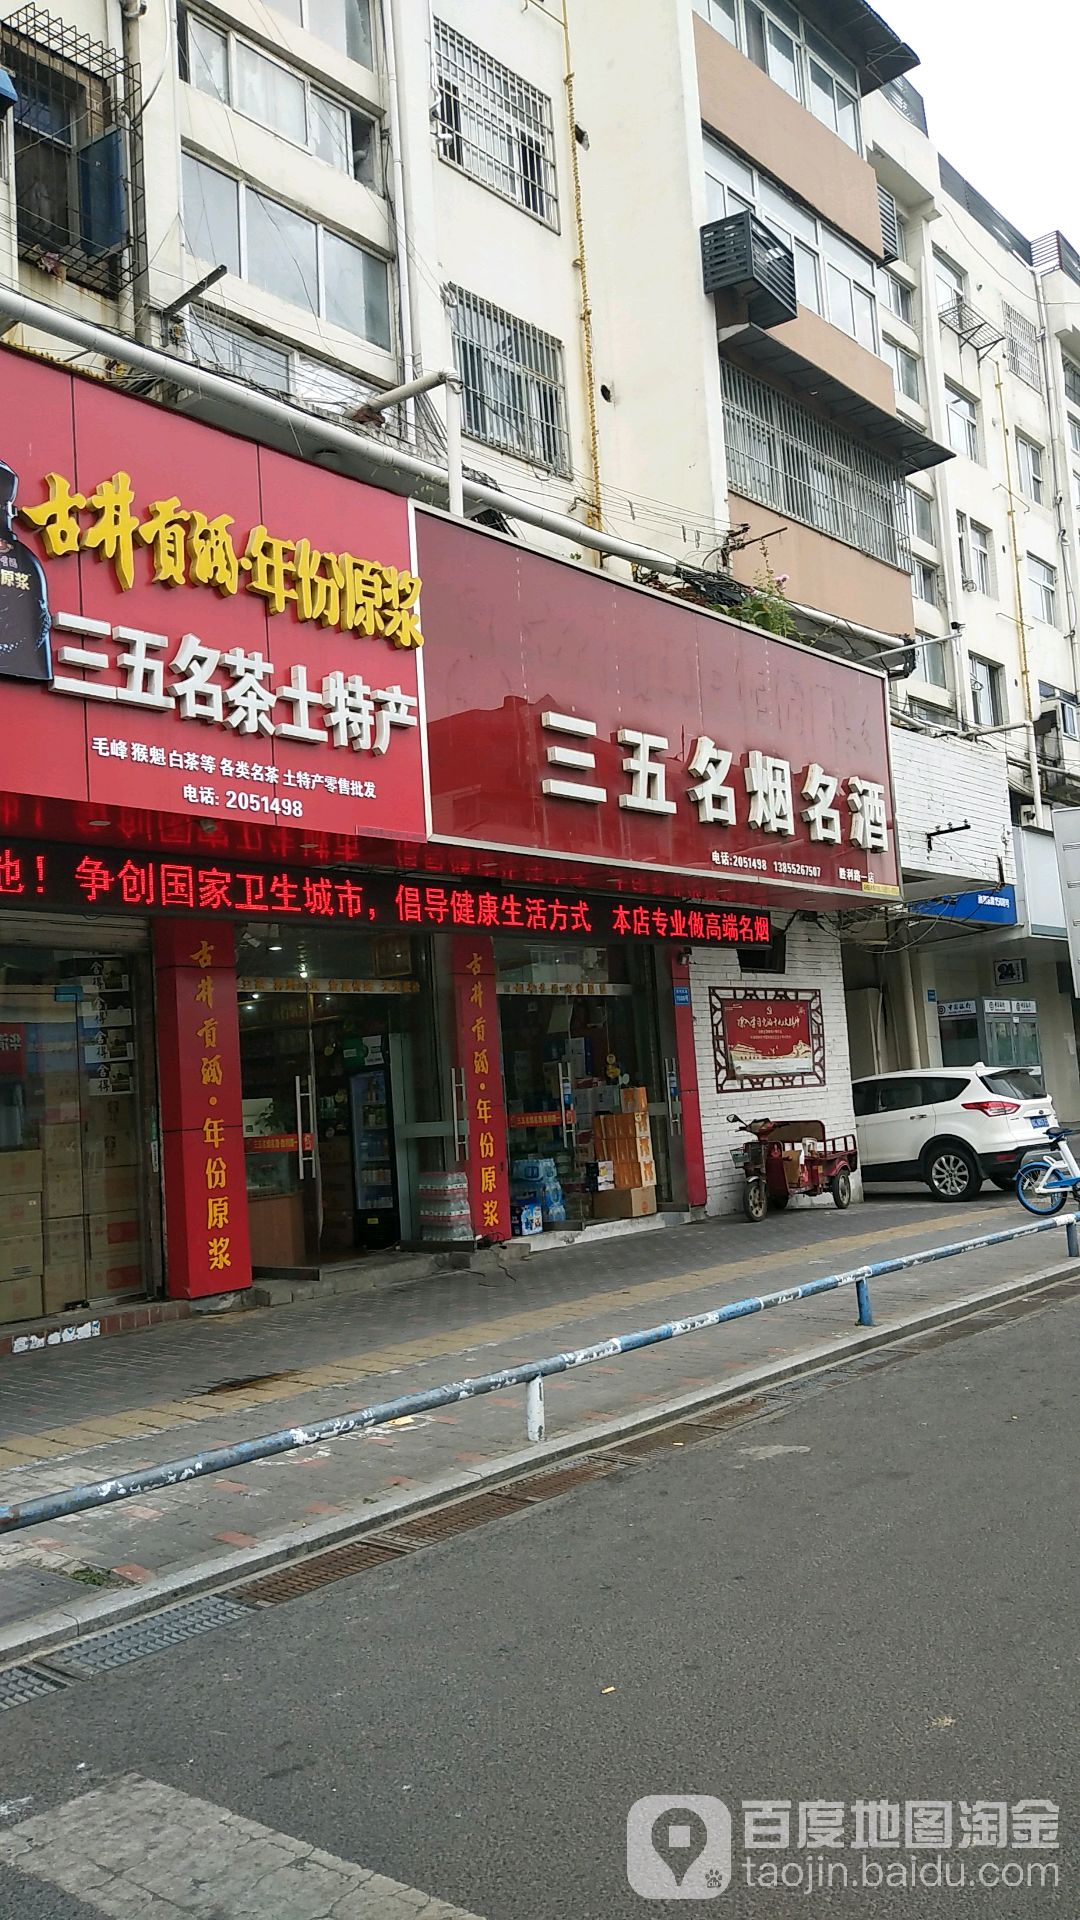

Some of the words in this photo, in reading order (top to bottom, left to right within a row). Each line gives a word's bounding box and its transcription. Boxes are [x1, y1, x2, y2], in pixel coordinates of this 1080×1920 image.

[49, 612, 418, 756] 三五名茶土特产
[92, 737, 128, 760] 毛峰
[131, 742, 167, 766] 猴魁
[169, 749, 217, 774] 白茶等
[220, 757, 279, 784] 各类名茶
[283, 769, 377, 799] 土特产零售批发
[541, 710, 889, 853] 三五名烟名酒
[226, 790, 303, 817] 2051498
[612, 905, 770, 943] 本店专业做高端名烟
